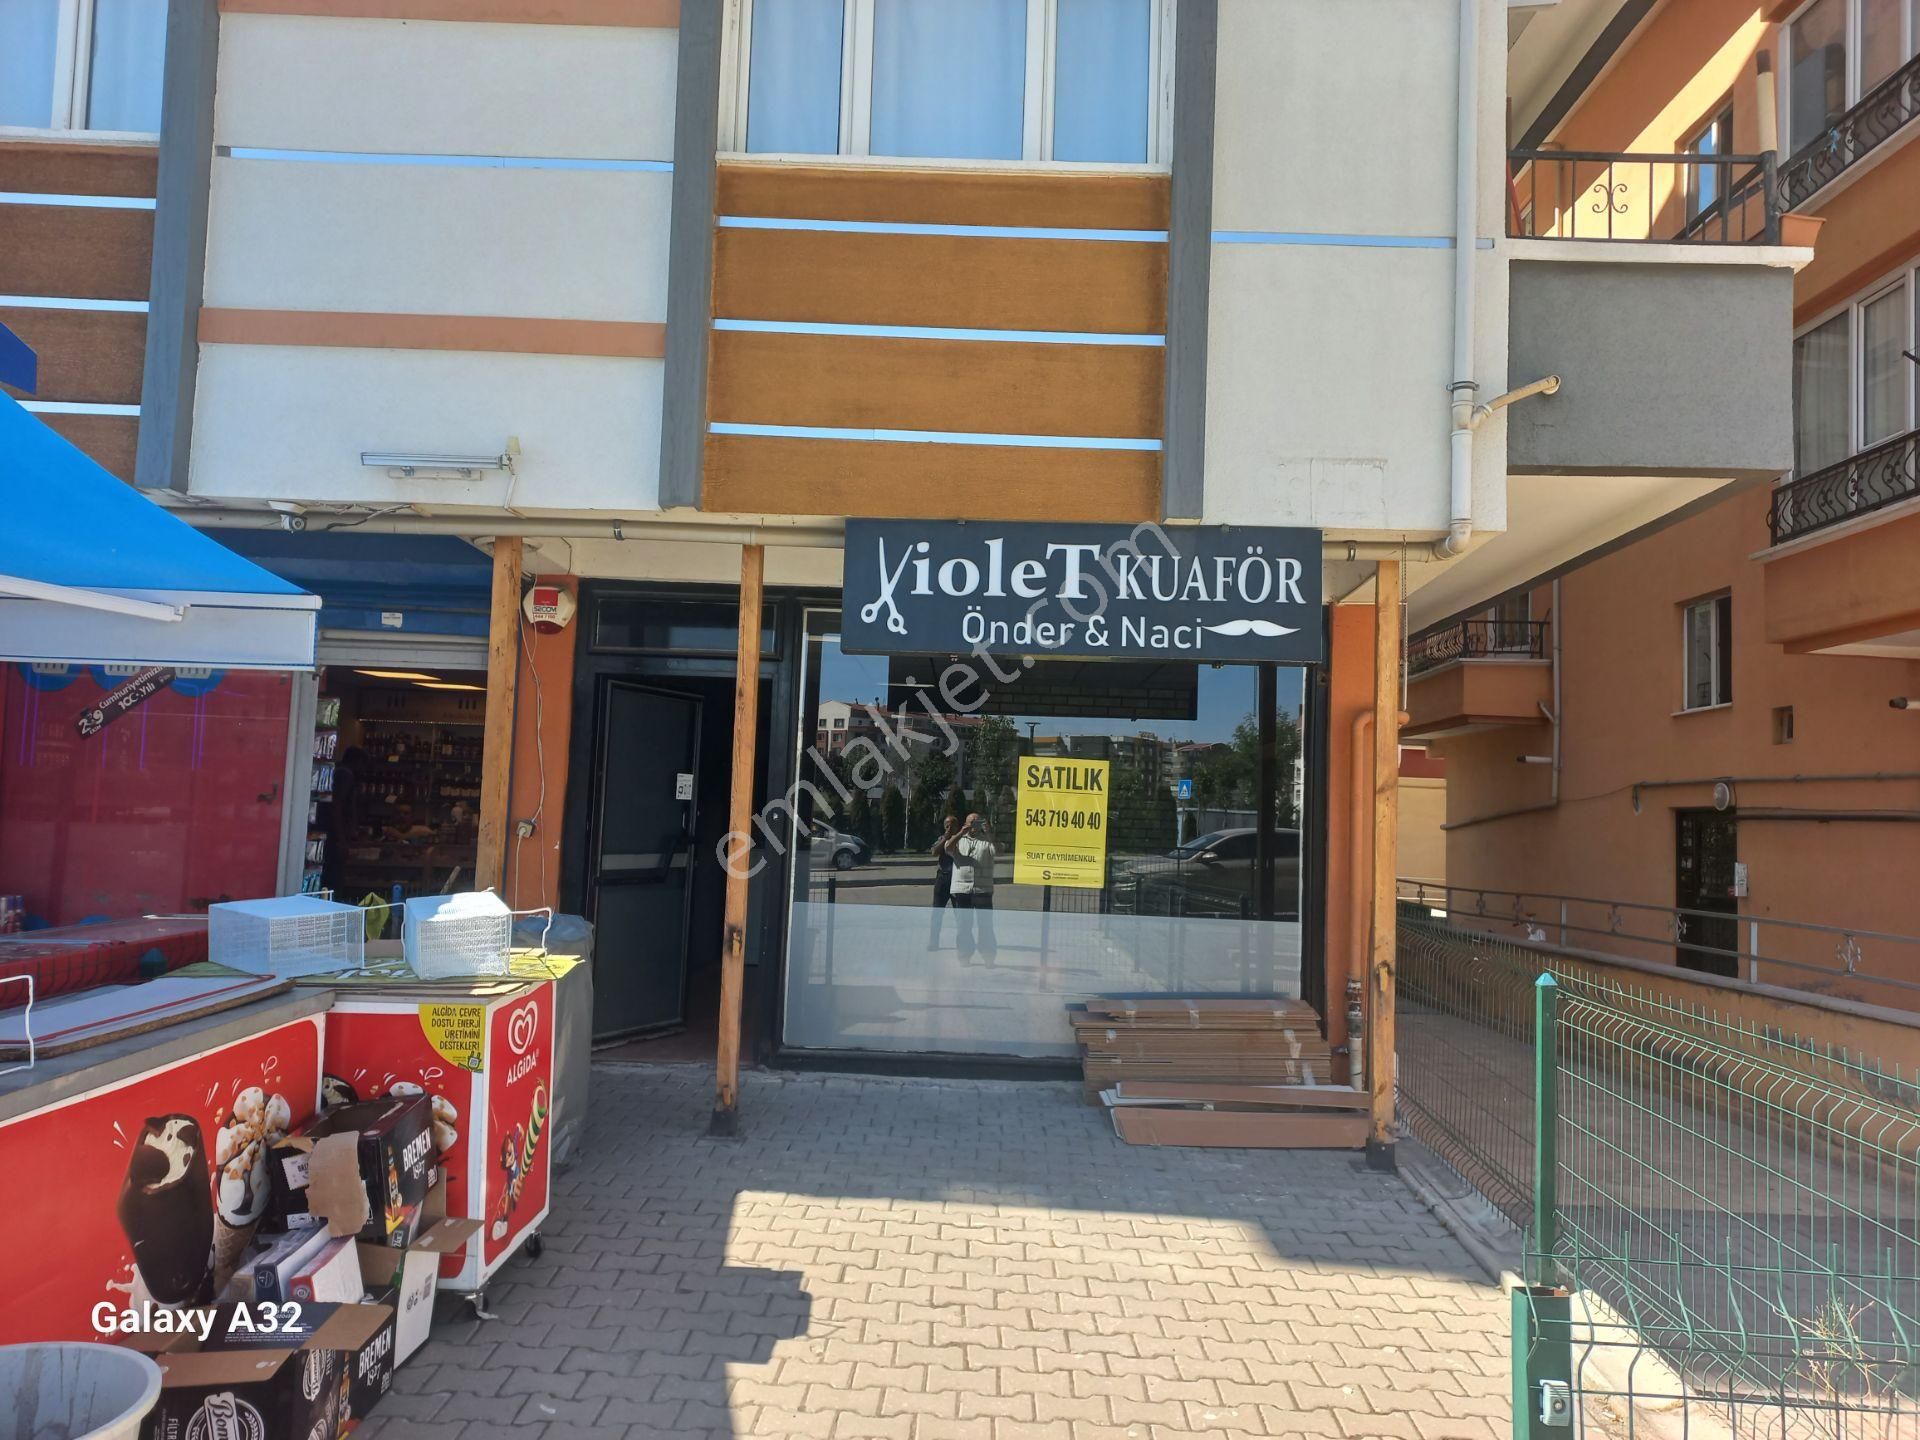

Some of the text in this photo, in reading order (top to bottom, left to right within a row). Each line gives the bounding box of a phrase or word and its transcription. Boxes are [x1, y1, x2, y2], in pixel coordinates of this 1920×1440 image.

[1116, 546, 1306, 604] KUAFÖR
[962, 605, 1202, 649] Önder & Naci
[1026, 764, 1103, 792] SATILIK
[1025, 808, 1101, 830] 543 719 40 40
[1026, 851, 1097, 864] SUAT GAYRİMENKUL
[431, 1005, 457, 1017] ALGİDA
[431, 1018, 455, 1028] DOSTU
[402, 1128, 432, 1172] BREMEN
[358, 1325, 392, 1379] BREMEN
